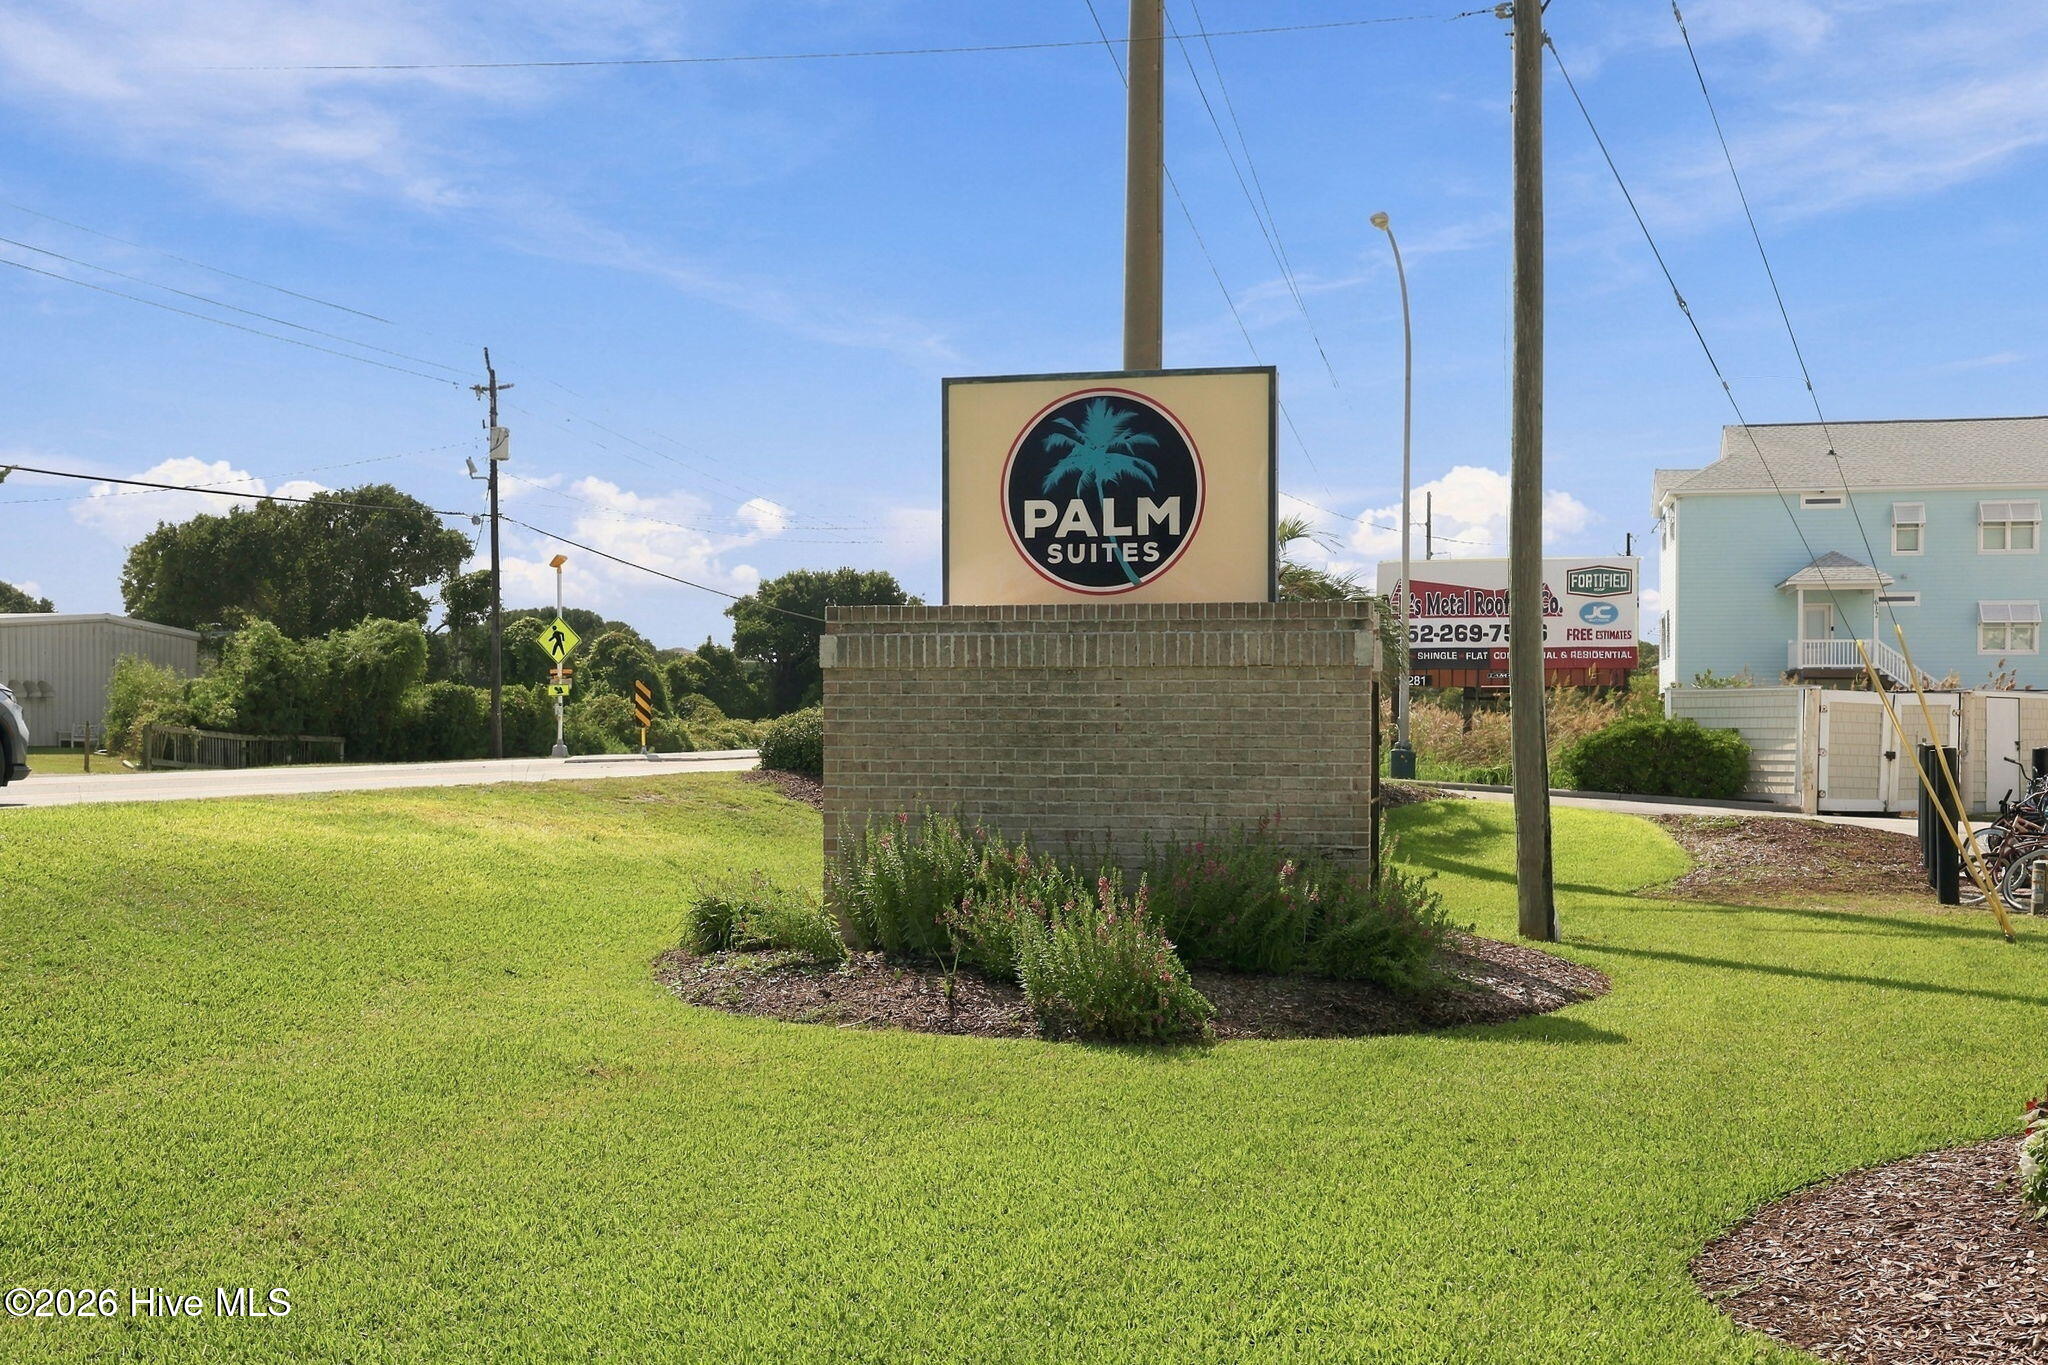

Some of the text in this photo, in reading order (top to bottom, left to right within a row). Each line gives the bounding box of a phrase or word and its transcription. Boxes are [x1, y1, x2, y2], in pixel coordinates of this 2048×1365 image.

[1024, 496, 1181, 539] PALM
[1047, 541, 1160, 565] SUITES
[1571, 573, 1628, 588] FORTIFIED
[1425, 590, 1471, 617] Metal
[1474, 590, 1510, 617] Roof
[1584, 606, 1612, 619] JC
[1567, 628, 1632, 641] FREE ESTIMATES
[1417, 651, 1458, 660] SHINGLE
[1465, 651, 1489, 660] FLAT
[1561, 651, 1568, 659] &
[1570, 650, 1633, 660] RESIDENTIAL
